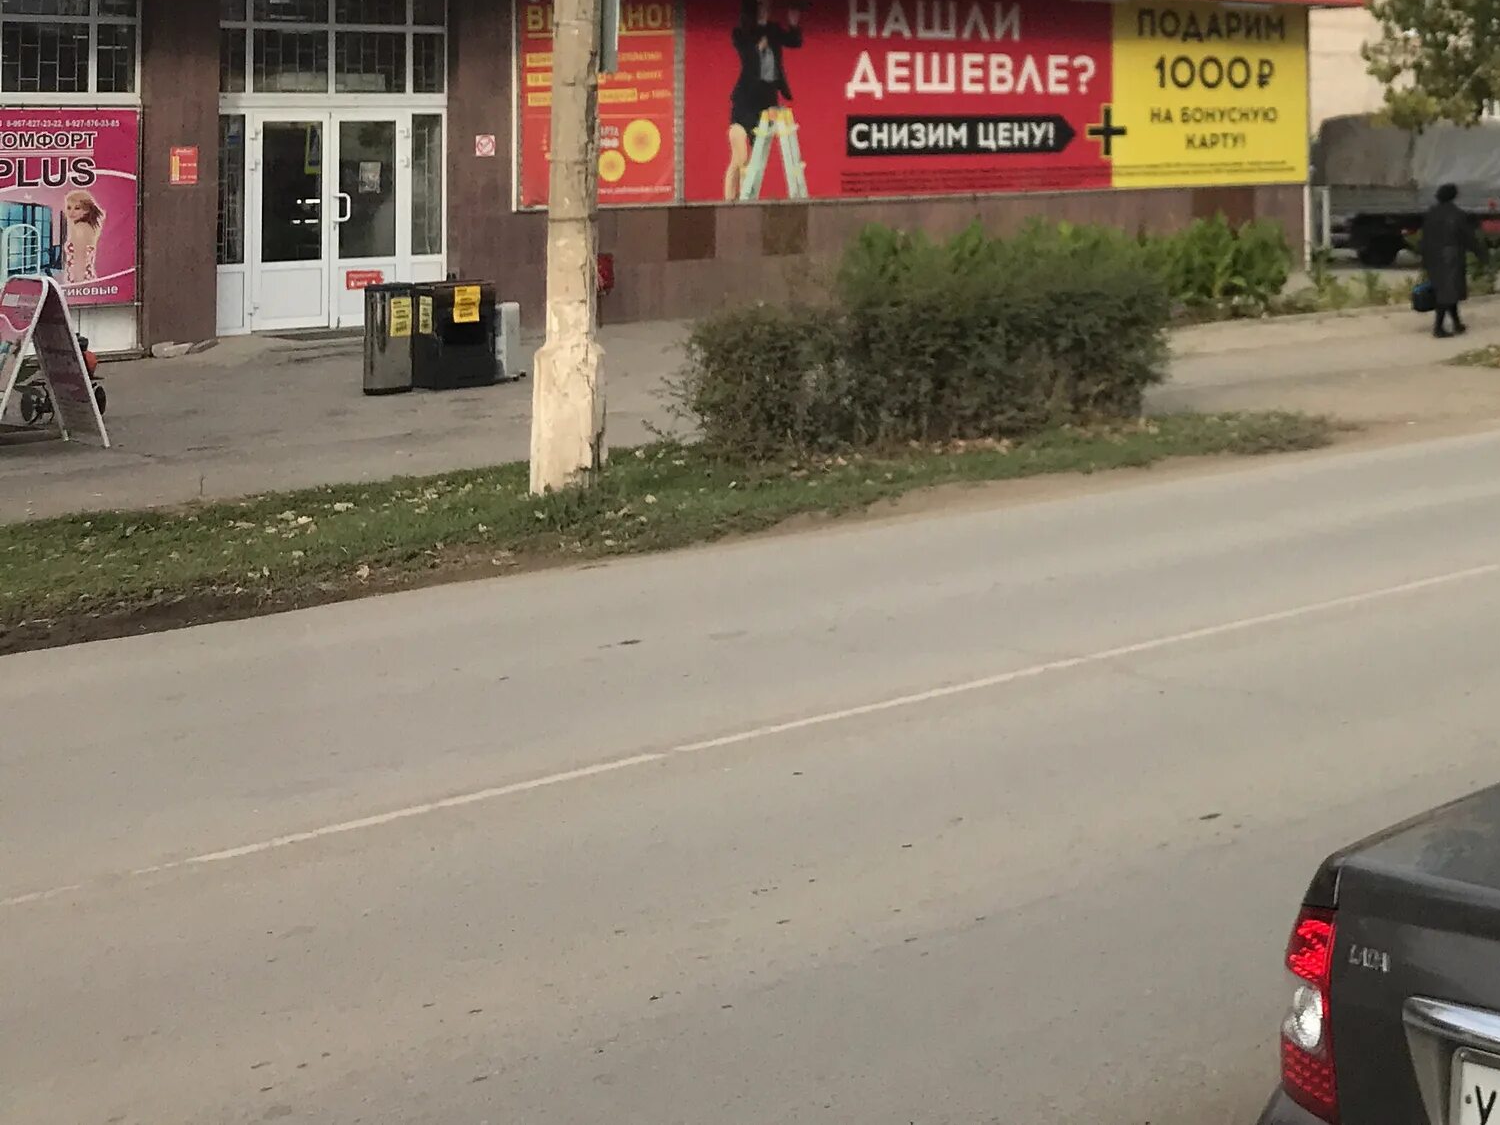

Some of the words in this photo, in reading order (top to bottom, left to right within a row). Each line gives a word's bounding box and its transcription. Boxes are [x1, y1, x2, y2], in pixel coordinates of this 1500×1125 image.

[1137, 8, 1286, 42] ПОДАРИМ
[845, 50, 1096, 100] ДЕШЕВЛЕ?
[1150, 107, 1173, 123] НА
[1180, 106, 1279, 124] БОНУСНУЮ
[0, 131, 97, 149] ОМФОРТ
[850, 122, 968, 150] СНИЗИМ
[977, 121, 1055, 152] ЦЕНУ!
[1185, 132, 1246, 150] КАРТУ!
[61, 285, 119, 296] тиковые
